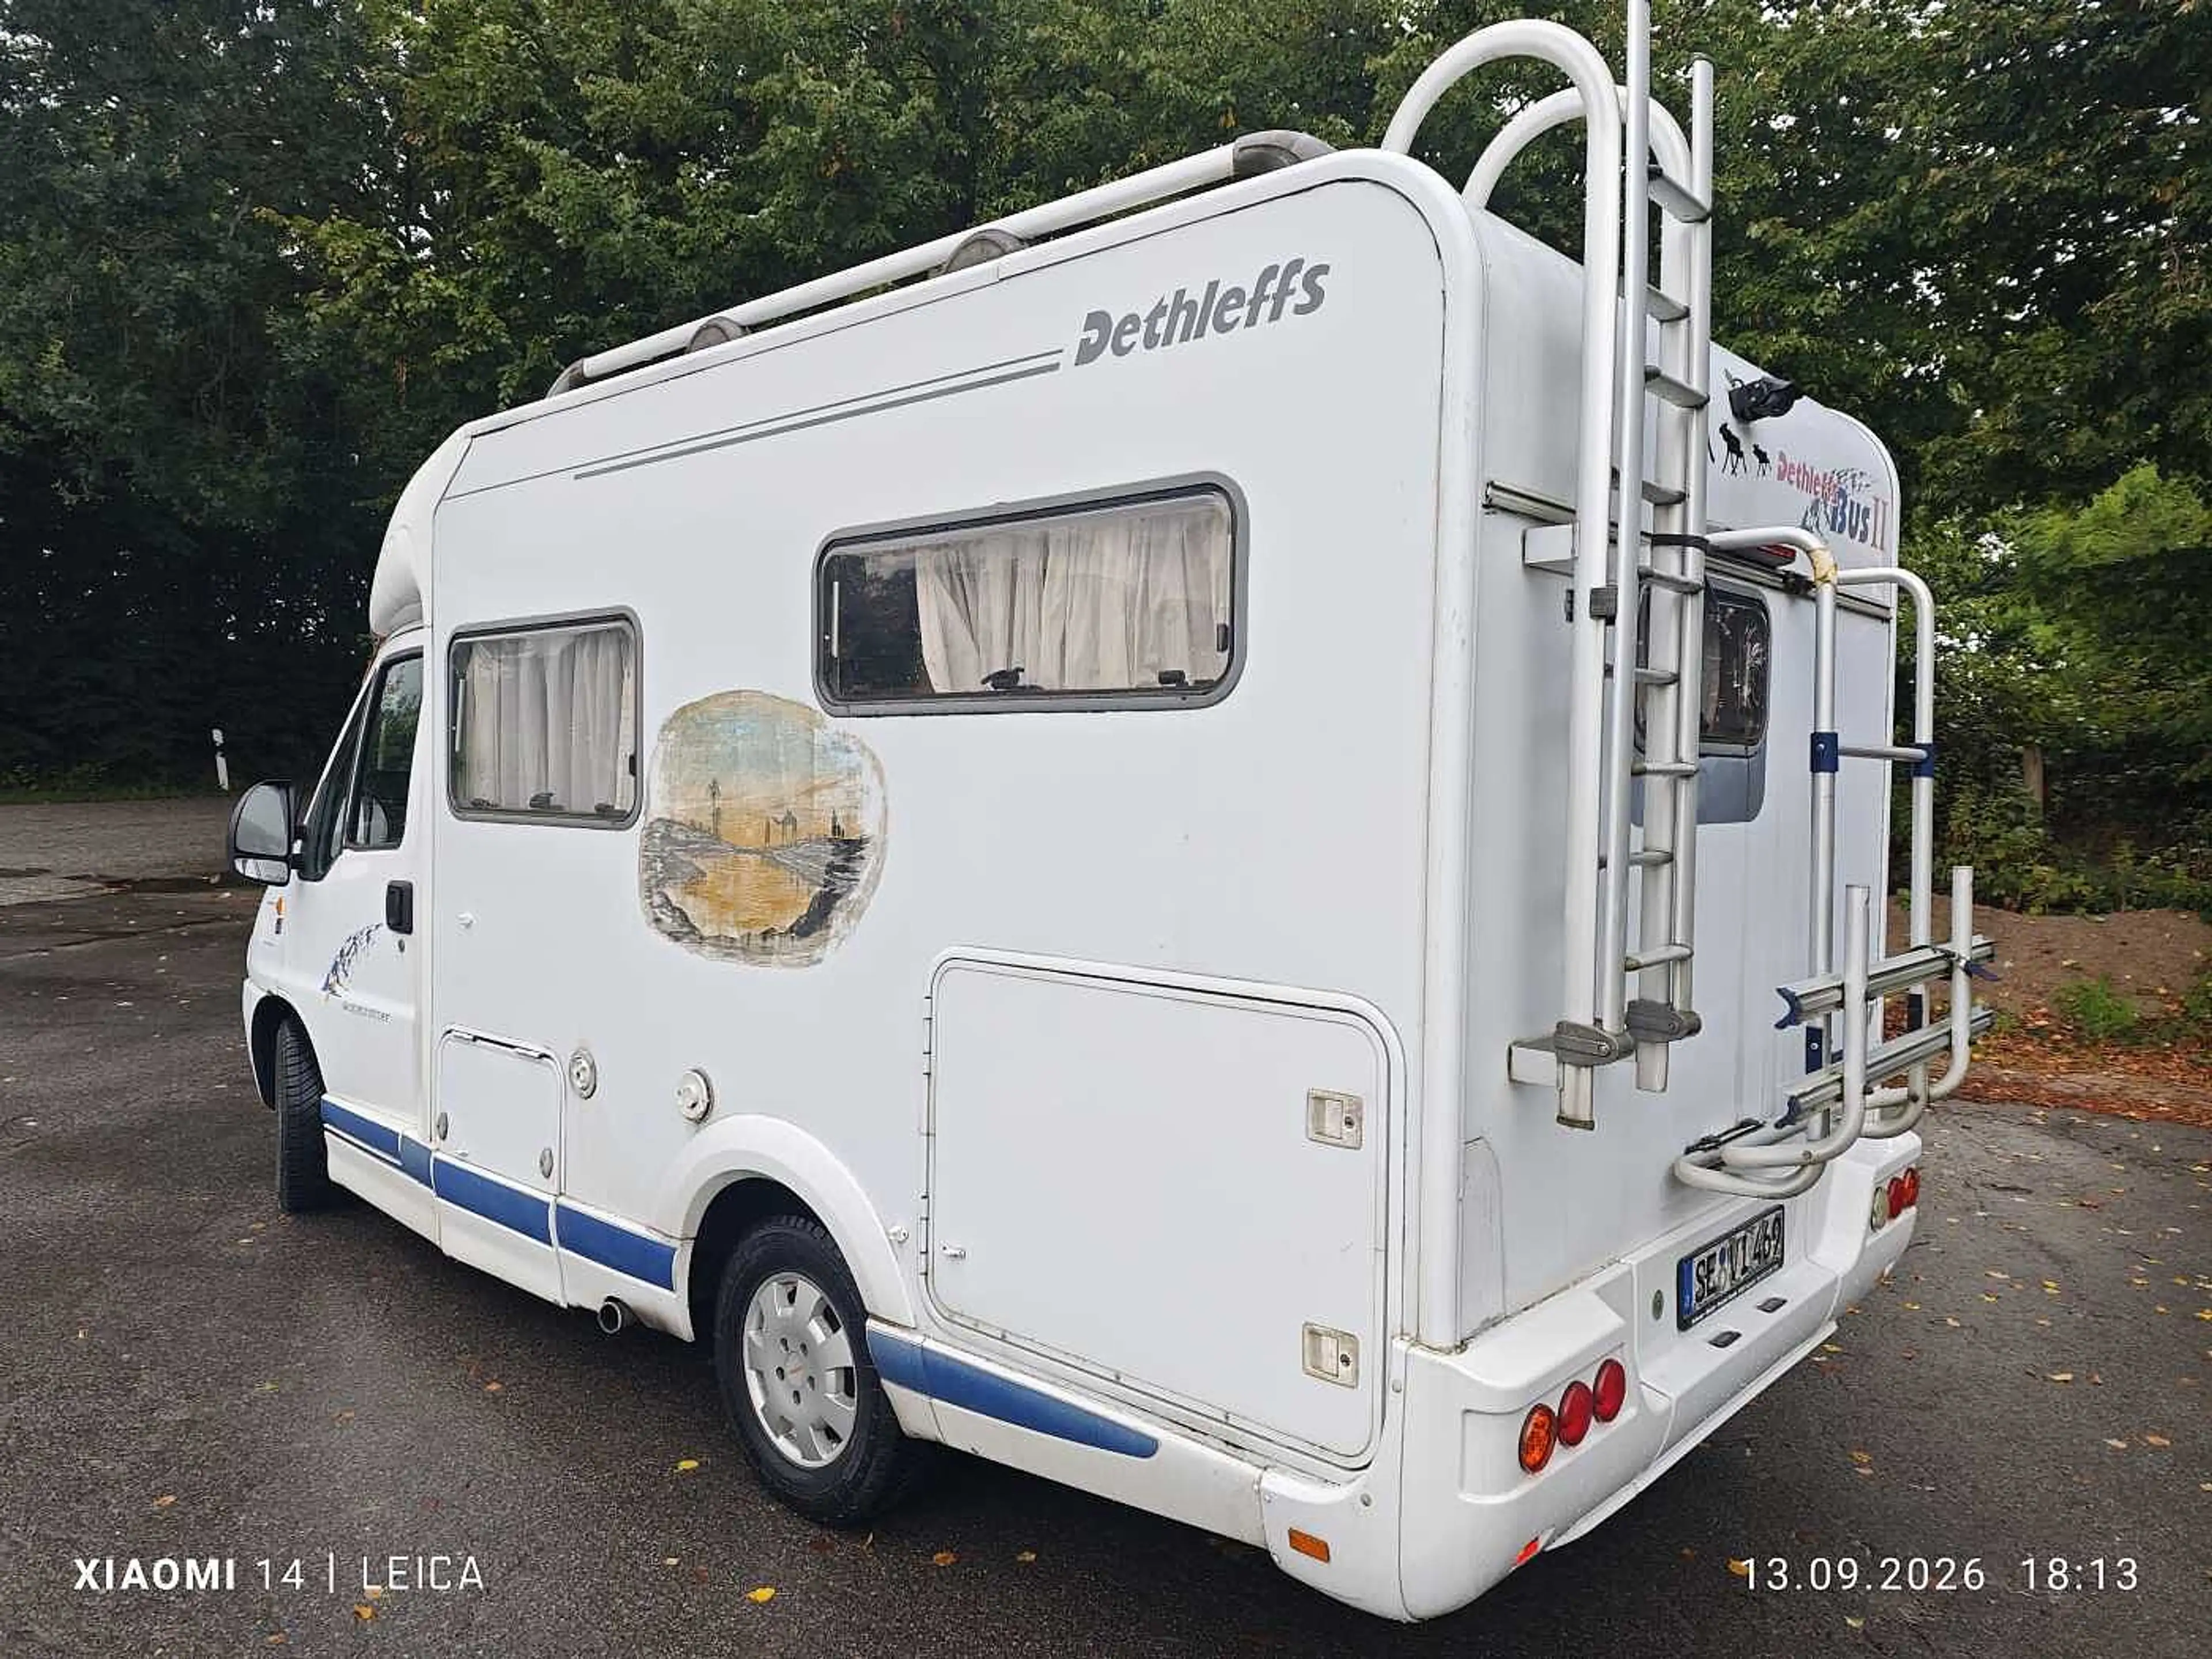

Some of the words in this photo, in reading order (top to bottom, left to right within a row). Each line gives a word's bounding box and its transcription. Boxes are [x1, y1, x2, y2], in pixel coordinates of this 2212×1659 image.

[1074, 257, 1330, 366] Dethleffs
[1695, 1252, 1717, 1303] SE
[1753, 1213, 1782, 1269] 469
